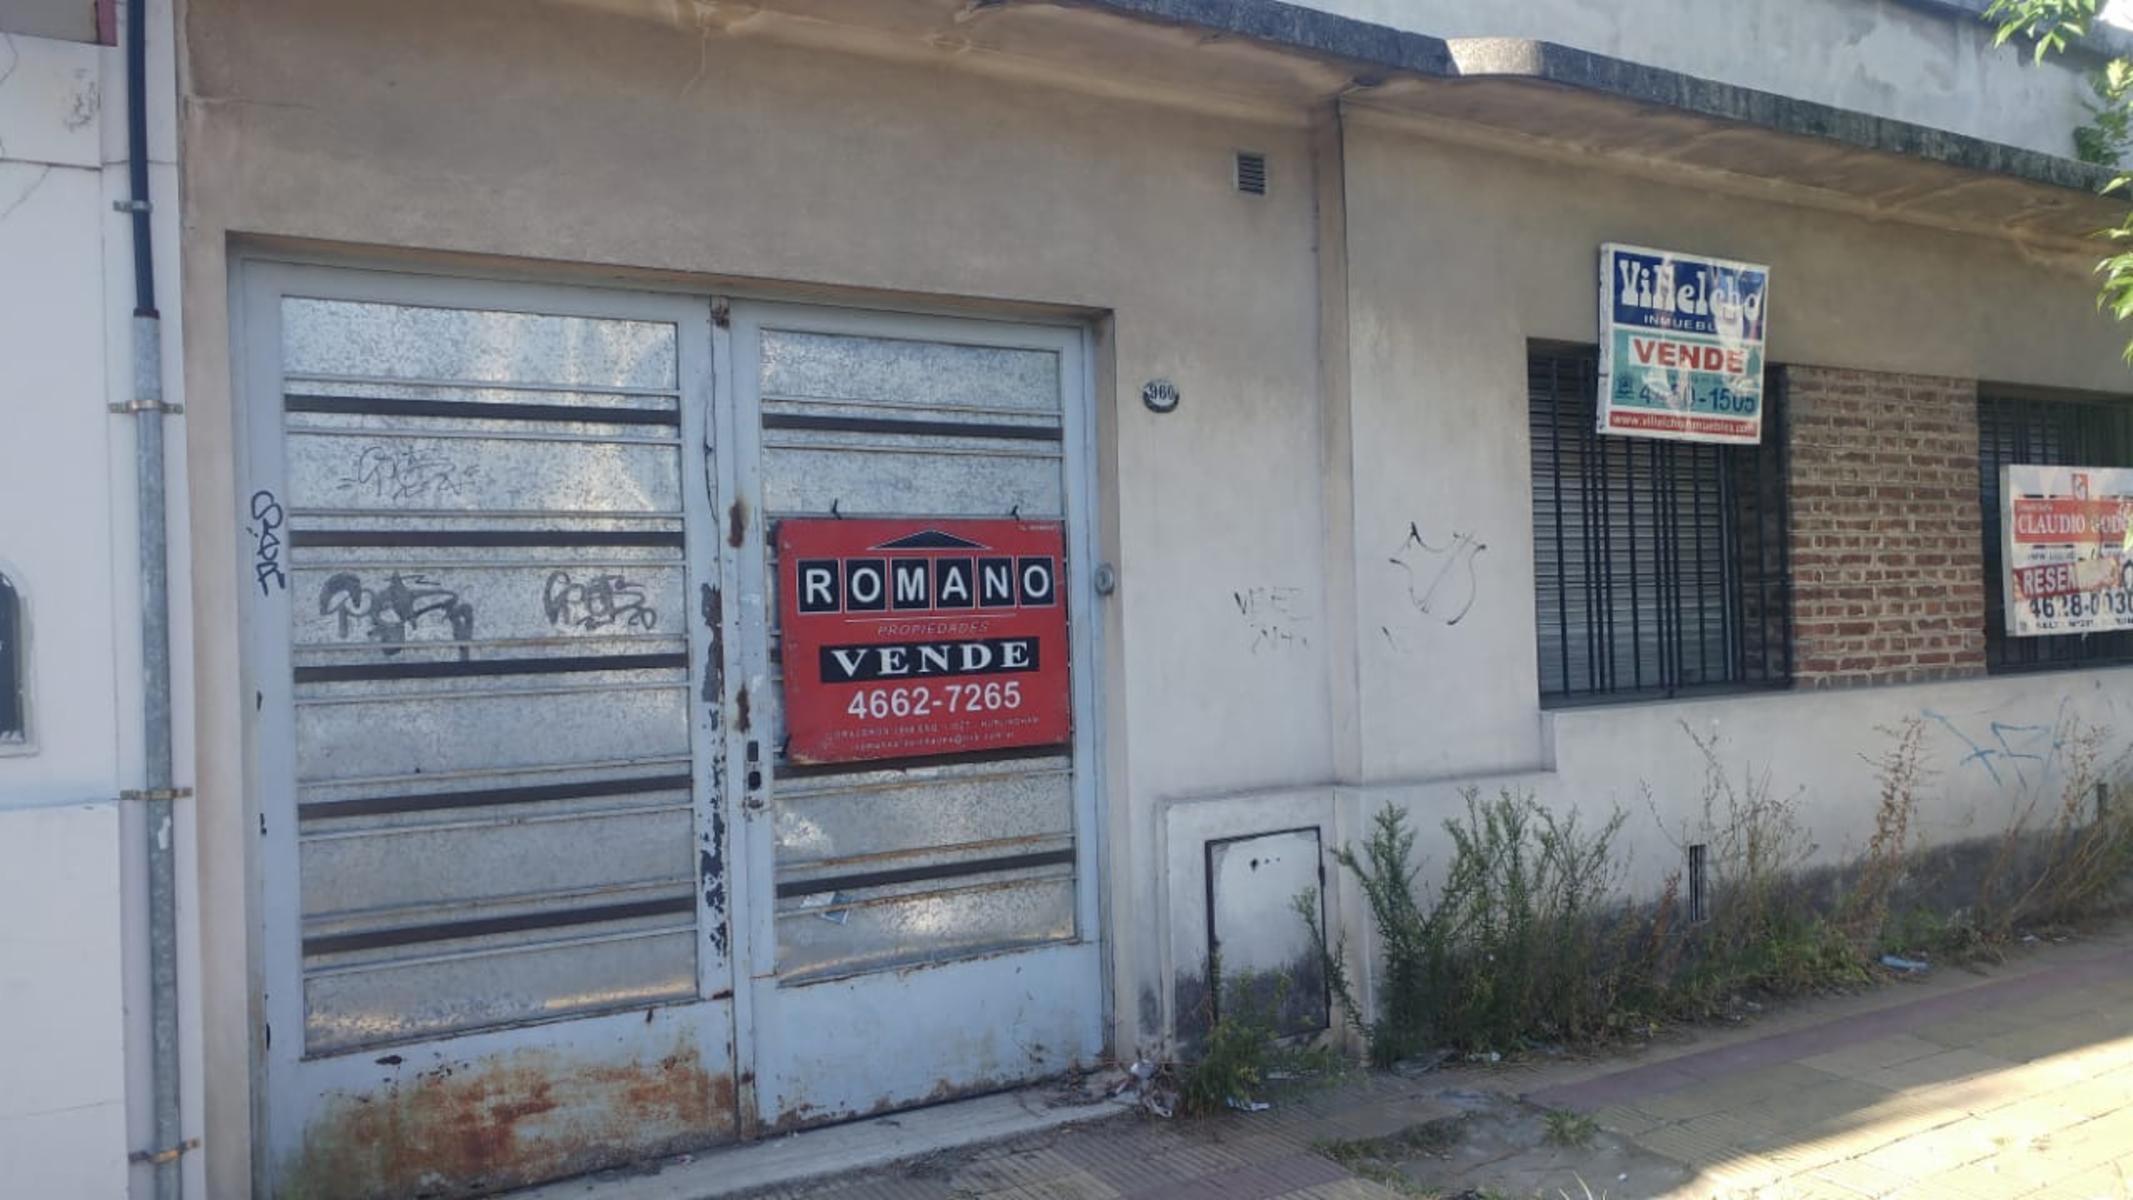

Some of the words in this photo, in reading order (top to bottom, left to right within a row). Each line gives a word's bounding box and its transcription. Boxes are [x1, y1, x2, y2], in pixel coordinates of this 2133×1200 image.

[1643, 313, 1720, 332] INMUEBL
[1634, 339, 1743, 373] VENDE
[2017, 513, 2086, 535] CLAUDIO
[805, 565, 1050, 604] ROMANO
[877, 621, 990, 637] PROPIEDADES
[830, 641, 1030, 678] VENDE
[847, 681, 1022, 719] 4662-7265
